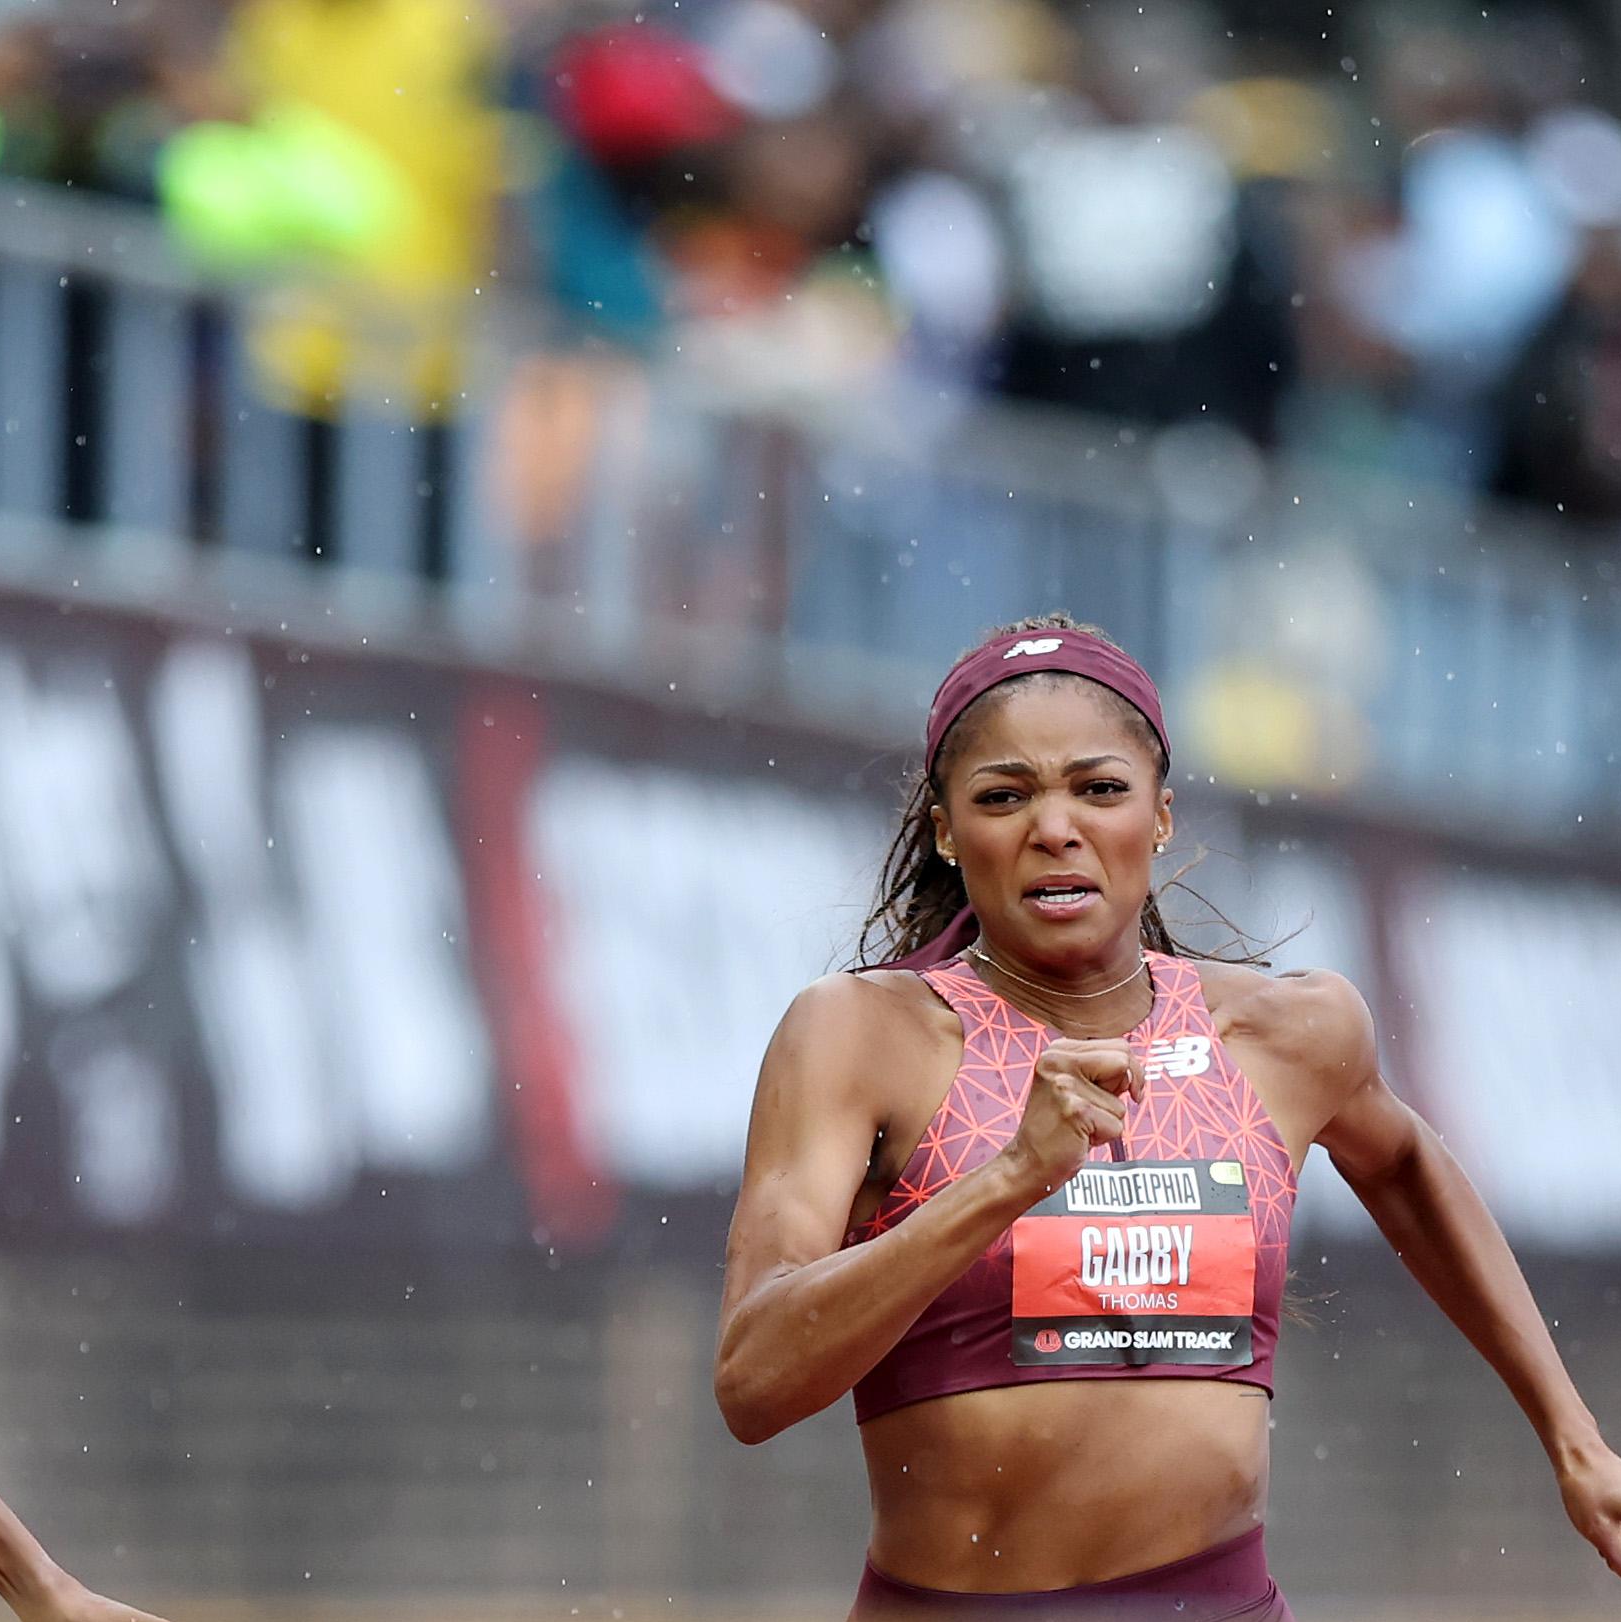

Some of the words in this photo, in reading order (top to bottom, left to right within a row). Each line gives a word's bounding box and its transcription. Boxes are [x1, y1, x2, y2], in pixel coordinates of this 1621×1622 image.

[1071, 1173, 1196, 1206] PHILADELPHIA
[1080, 1224, 1194, 1287] GABBY
[1098, 1292, 1179, 1311] THOMAS
[1064, 1331, 1132, 1349] GRAND
[1133, 1331, 1175, 1349] SLAM
[1175, 1331, 1236, 1350] TRACK
